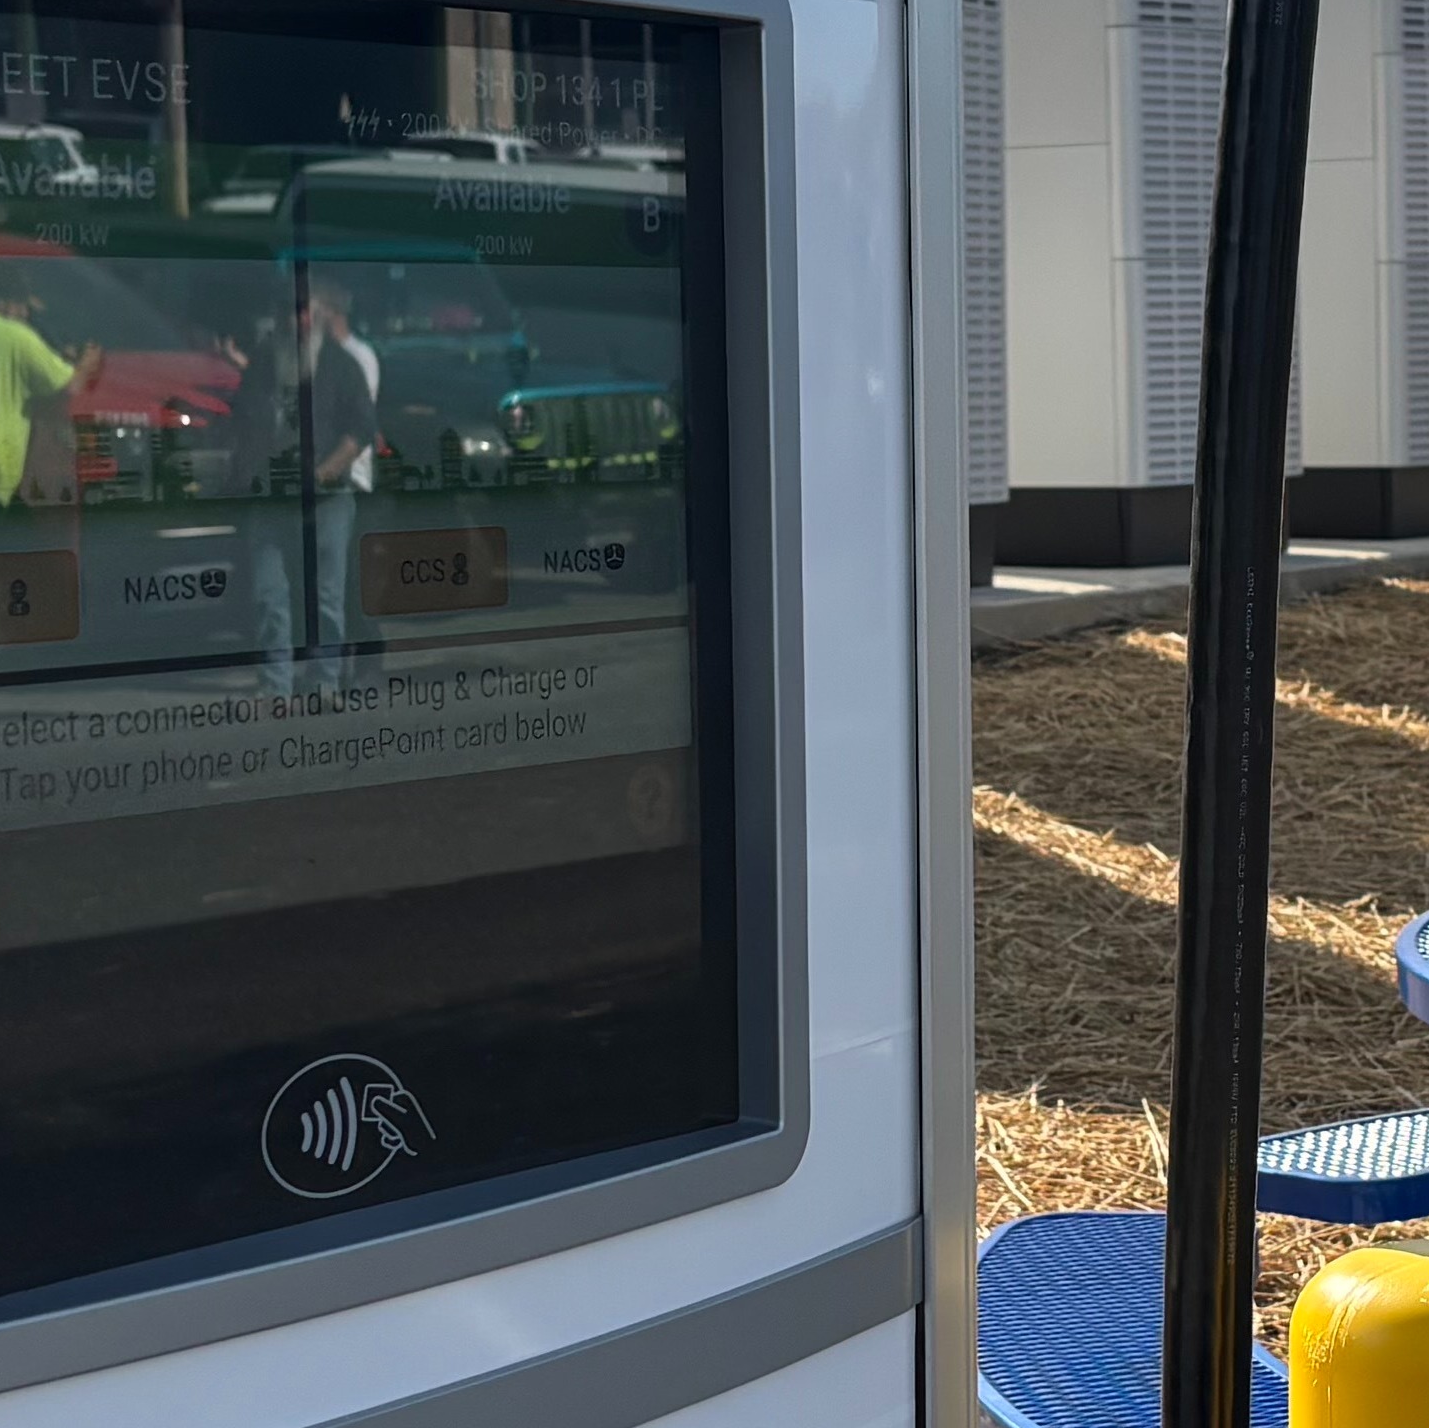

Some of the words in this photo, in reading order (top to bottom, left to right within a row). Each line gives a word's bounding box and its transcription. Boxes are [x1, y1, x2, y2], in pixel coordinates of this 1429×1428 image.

[92, 58, 191, 105] EVSE
[401, 111, 442, 138] 200
[559, 121, 618, 147] Power
[432, 170, 571, 214] Available
[642, 195, 661, 234] B
[34, 223, 74, 247] 200
[78, 224, 109, 248] kW
[474, 234, 505, 256] 200
[508, 234, 534, 257] kW
[399, 557, 446, 585] CCS
[542, 546, 602, 574] NACS
[123, 572, 197, 606] NACS
[88, 714, 104, 739] a
[114, 697, 264, 738] connector
[270, 686, 323, 721] and
[330, 687, 379, 717] use
[387, 674, 446, 714] Plug
[453, 674, 471, 702] &
[479, 665, 567, 704] Charge
[573, 663, 598, 692] or
[64, 761, 128, 804] your
[142, 748, 233, 794] phone
[241, 745, 270, 775] or
[278, 726, 447, 772] ChargePoint
[452, 719, 506, 753] card
[514, 707, 589, 743] below
